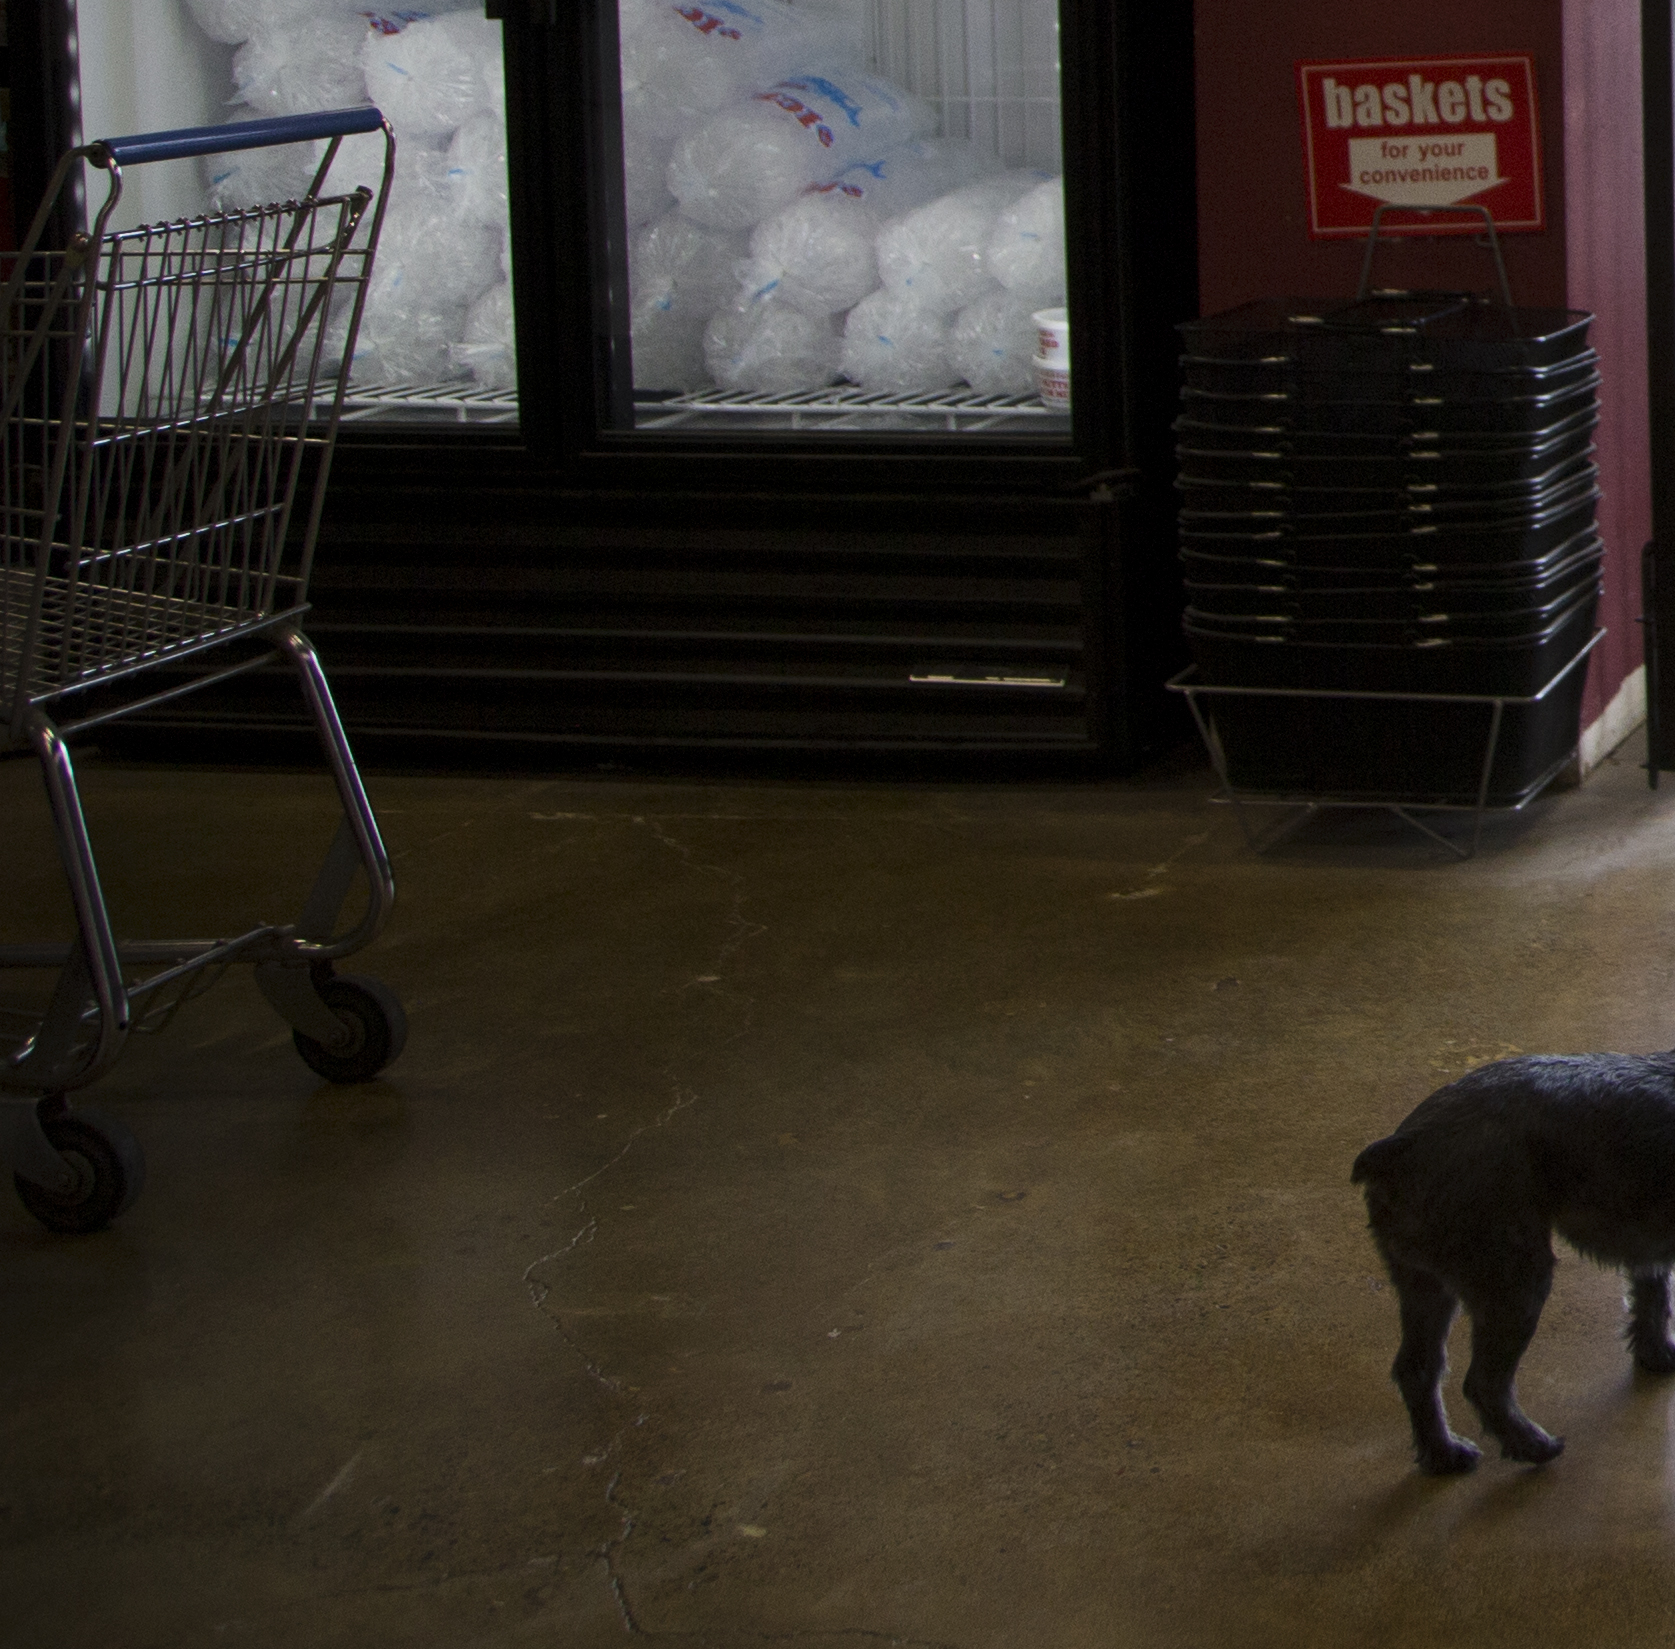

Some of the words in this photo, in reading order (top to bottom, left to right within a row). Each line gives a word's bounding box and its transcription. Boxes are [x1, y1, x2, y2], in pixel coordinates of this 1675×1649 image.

[1322, 74, 1514, 129] baskets
[1380, 141, 1410, 159] for
[1418, 141, 1466, 163] your
[1359, 164, 1490, 185] convenience
